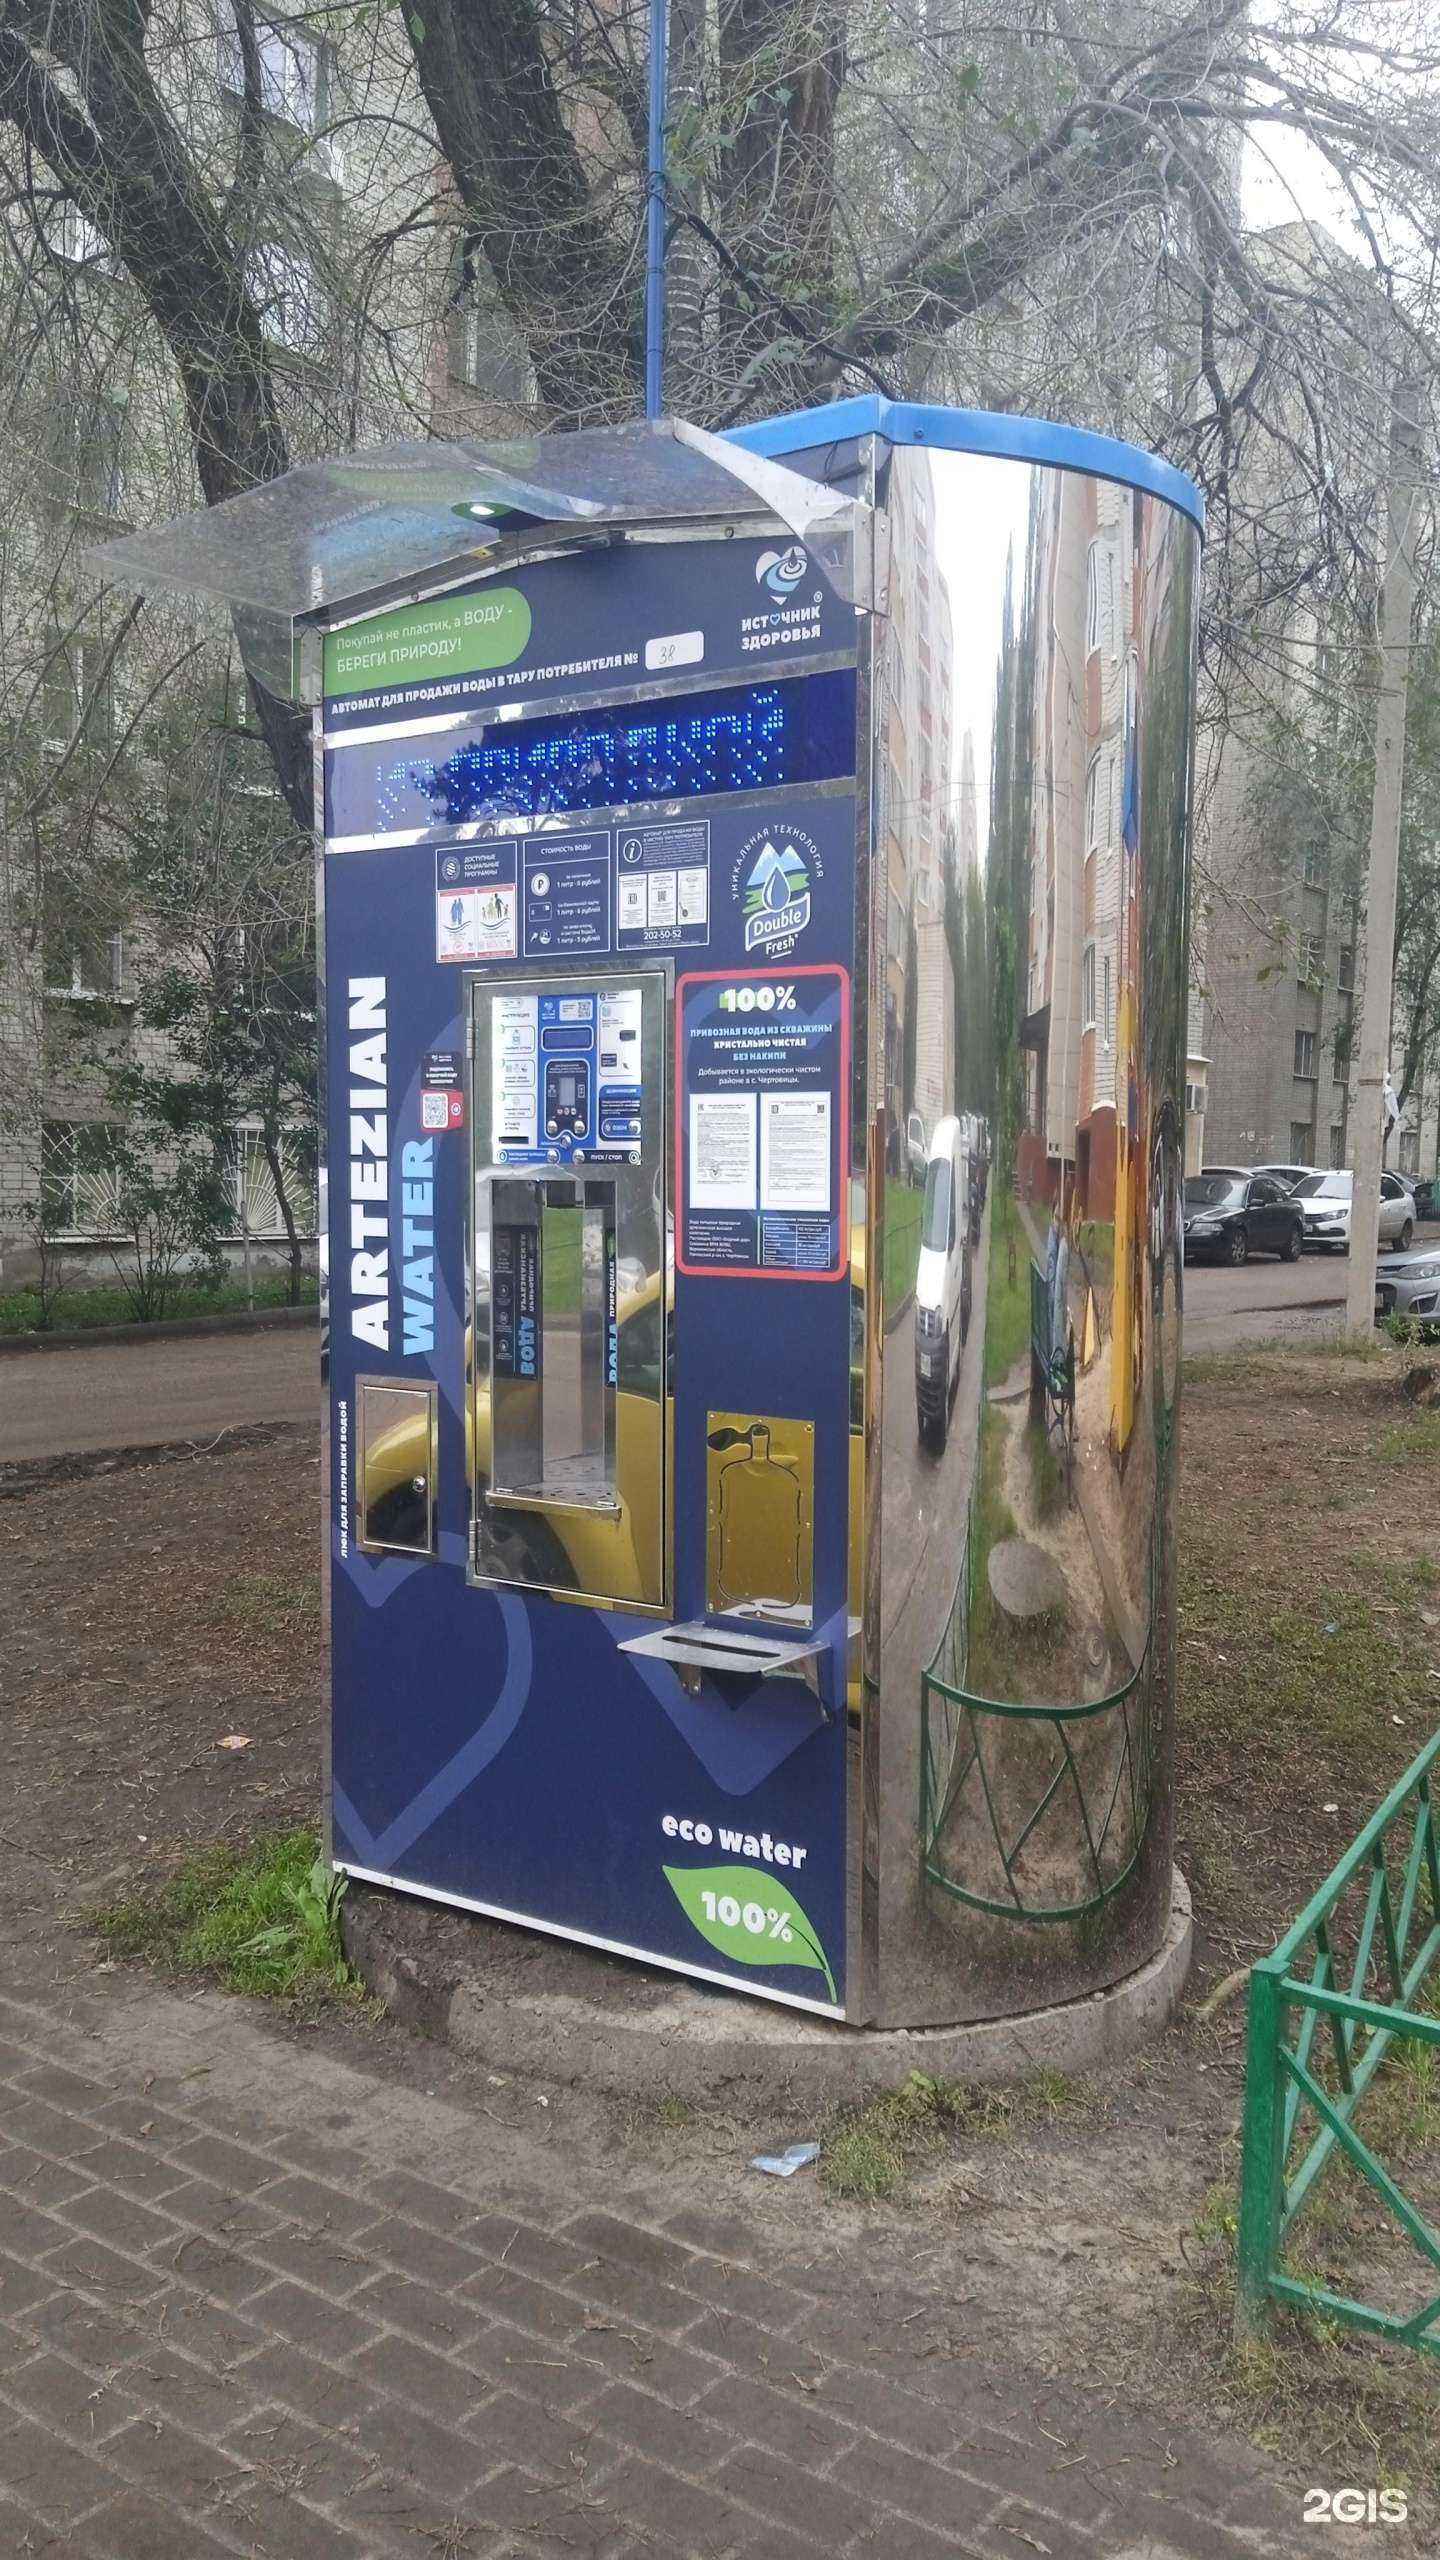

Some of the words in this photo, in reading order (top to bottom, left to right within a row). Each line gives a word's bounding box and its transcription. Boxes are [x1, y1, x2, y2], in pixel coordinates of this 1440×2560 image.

[337, 631, 384, 650] Покупай
[386, 630, 399, 640] не
[402, 620, 452, 637] пластик,
[454, 617, 461, 628] а
[464, 604, 505, 626] ВОДУ
[741, 624, 821, 651] ЗДОРОВЬЯ
[337, 652, 387, 673] БЕРЕГИ
[391, 637, 462, 663] ПРИРОДУ!
[331, 696, 381, 715] АВТОМАТ
[382, 692, 404, 708] ДЛЯ
[405, 683, 461, 702] ПРОДАЖИ
[462, 677, 497, 693] ВОДЫ
[498, 675, 506, 687] В
[507, 669, 537, 685] ТАРУ
[537, 654, 622, 680] ПОТРЕБИТЕЛЯ
[623, 652, 639, 665] №
[464, 853, 496, 863] ДОСТУПНЫЕ
[541, 845, 574, 854] СТОИМОСТЬ
[574, 843, 592, 851] ВОДЫ
[729, 826, 769, 900] УНИКАЛЬНАЯ
[774, 824, 824, 879] ТЕХНОЛОГИЯ
[464, 861, 500, 870] СОЦИАЛЬНЫЕ
[643, 928, 682, 940] 202-50-52
[753, 908, 802, 937] Double
[724, 985, 797, 1013] 100%
[690, 1027, 743, 1038] ПРИВОЗНАЯ
[743, 1026, 767, 1037] ВОДА
[767, 1026, 779, 1035] ИЗ
[779, 1024, 833, 1034] СКВАЖИНЫ
[713, 1039, 771, 1050] КРИСТАЛЬНО
[771, 1037, 807, 1048] ЧИСТАЯ
[733, 1052, 749, 1061] БЕЗ
[749, 1051, 787, 1061] НАКИПИ
[698, 1067, 739, 1077] Добывается
[745, 1066, 795, 1076] экологически
[795, 1066, 821, 1074] чистом
[718, 1076, 745, 1085] районе
[348, 975, 390, 1353] ARTEZIAN
[401, 1137, 435, 1356] WATER
[338, 1400, 348, 1442] ВОДОЙ
[340, 1443, 348, 1508] ЗАПРАВКИ
[340, 1508, 349, 1529] ДЛЯ
[340, 1528, 348, 1559] ЛЮК
[662, 1815, 713, 1846] eco
[718, 1828, 808, 1869] water
[701, 1891, 793, 1943] 100%
